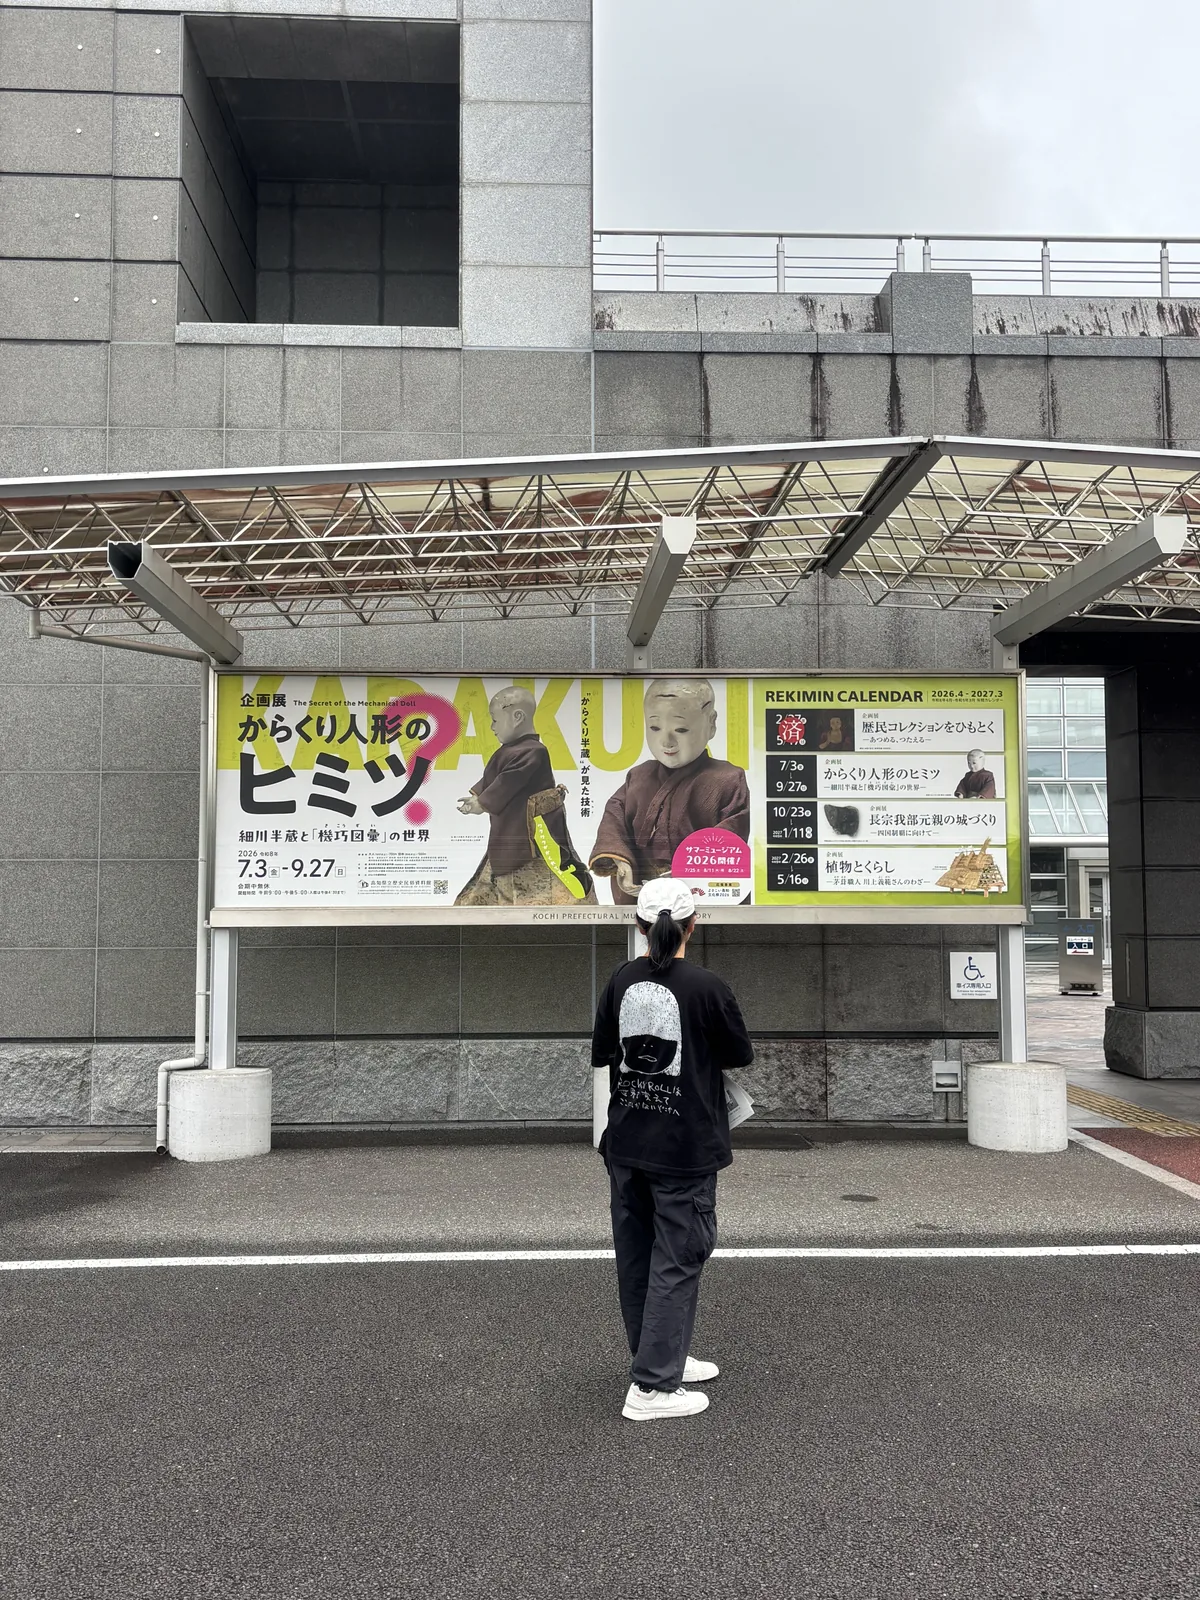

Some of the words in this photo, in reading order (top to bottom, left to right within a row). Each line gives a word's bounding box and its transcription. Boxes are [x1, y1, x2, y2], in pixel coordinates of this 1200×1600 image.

[240, 693, 287, 708] 企画展
[293, 699, 307, 707] The
[308, 699, 332, 707] Secret
[334, 699, 343, 707] of
[344, 699, 356, 707] the
[358, 699, 399, 708] Mechanical
[765, 690, 834, 703] REKIMIN
[837, 690, 924, 703] CALENDAR
[931, 690, 963, 698] 2026.4
[971, 690, 1003, 698] 2027.3
[237, 713, 431, 745] からくり人形の
[782, 719, 803, 741] 済
[861, 720, 995, 734] 歴民コレクションをひもとく
[824, 767, 941, 781] からくり人形のヒミツ
[239, 752, 432, 818] ヒミツ
[869, 813, 997, 826] 長宗我部元親の城づくり
[685, 846, 743, 854] サマーミュージアム
[237, 858, 267, 878] 7.3
[291, 858, 335, 878] 9.27
[825, 860, 895, 874] 植物とくらし
[532, 912, 559, 920] KOCHI
[562, 912, 619, 920] PREFECTURAL
